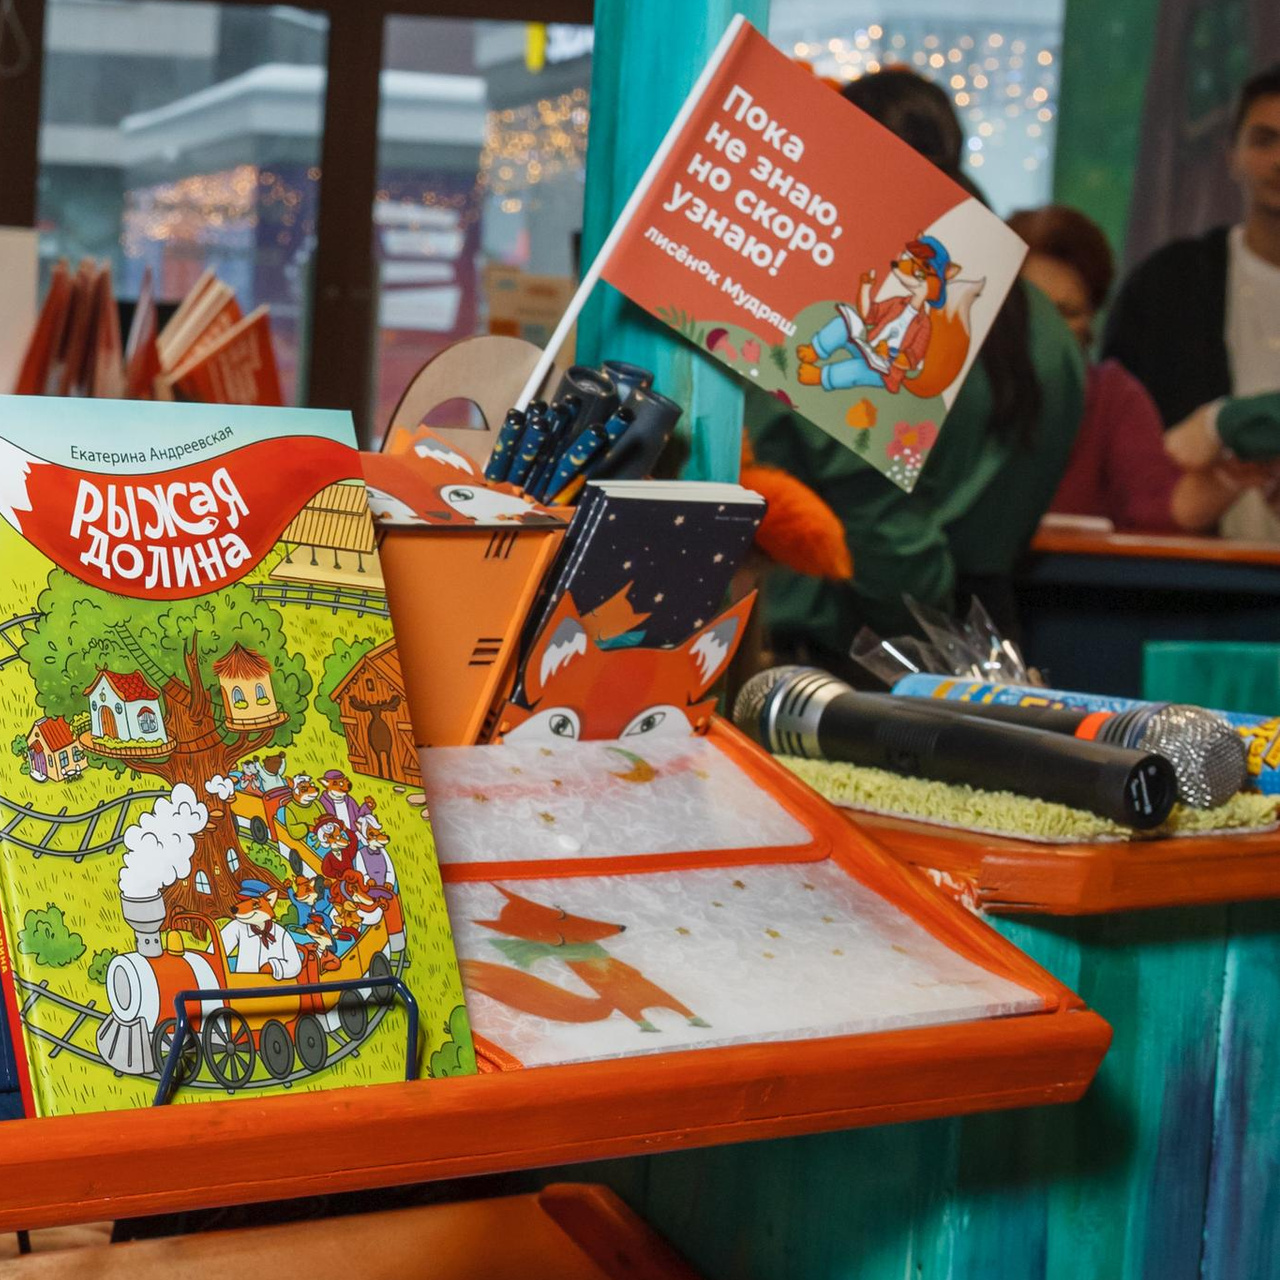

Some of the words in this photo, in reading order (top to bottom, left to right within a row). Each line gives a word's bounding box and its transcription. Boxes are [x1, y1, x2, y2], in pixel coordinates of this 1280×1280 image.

[721, 84, 805, 163] Пока
[662, 183, 789, 276] узнаю!
[687, 153, 732, 192] но
[734, 187, 835, 268] скоро
[705, 122, 746, 164] не
[750, 156, 844, 240] знаю,
[644, 227, 719, 287] лисёнок
[721, 276, 798, 337] Мудряш
[69, 444, 147, 467] Екатерина
[148, 424, 235, 464] Андреевская
